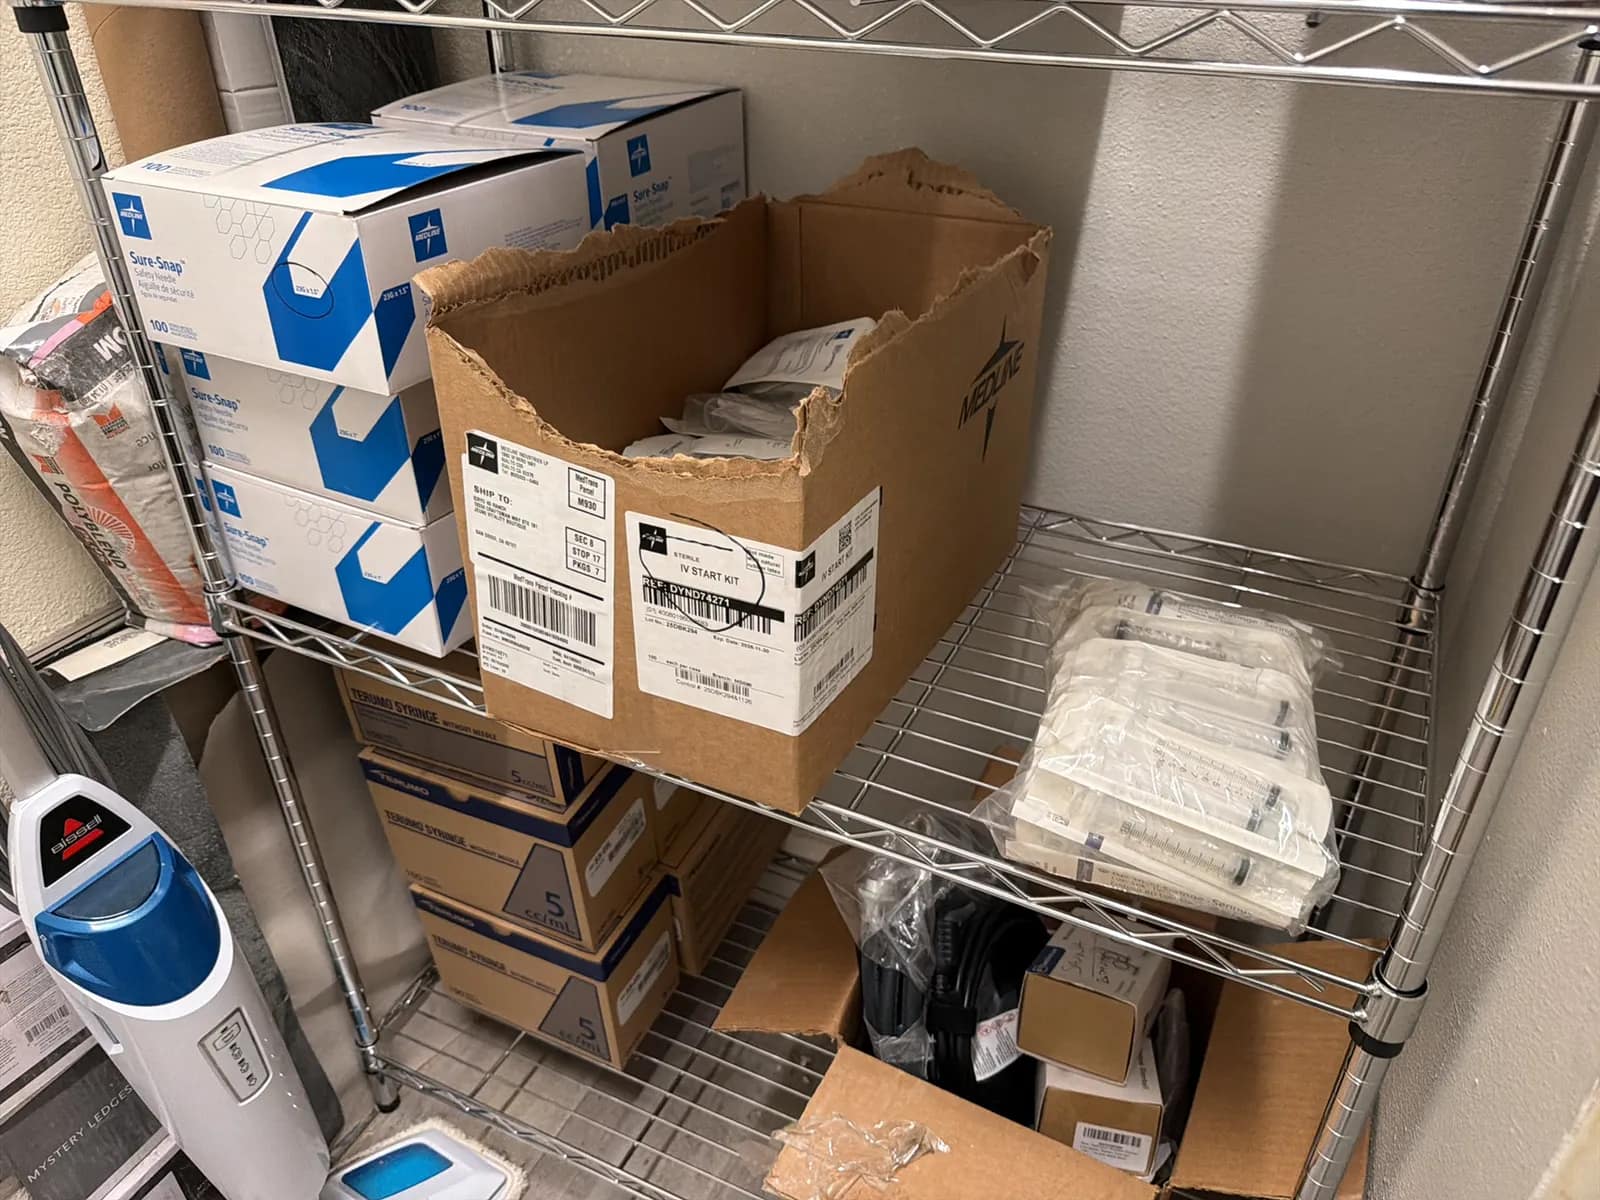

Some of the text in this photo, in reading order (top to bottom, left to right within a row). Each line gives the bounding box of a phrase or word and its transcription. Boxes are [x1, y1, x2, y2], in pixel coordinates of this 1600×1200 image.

[415, 226, 441, 242] MEDLINE
[129, 251, 183, 276] Sure-Snap
[150, 319, 169, 333] 100
[958, 341, 1024, 430] MEDLINE
[192, 387, 239, 412] Sure-Snap
[208, 444, 226, 458] 100
[575, 473, 598, 488] MedTrans
[474, 485, 495, 498] SHIP
[498, 493, 512, 506] TO:
[578, 497, 597, 511] M930
[54, 481, 127, 570] POLYBLEND
[574, 533, 594, 548] SEC 8
[572, 547, 601, 563] STOP 17
[674, 551, 700, 563] STERILE
[572, 560, 599, 576] PKGS 7
[680, 563, 740, 586] IV START KIT
[828, 556, 845, 578] START
[642, 578, 730, 607] REF: DYND74271
[351, 687, 394, 711] TERUMO
[395, 700, 439, 724] SYRINGE
[380, 771, 430, 797] TERUMO
[511, 770, 521, 784] 5
[545, 891, 565, 918] 5
[578, 1017, 596, 1041] 5
[27, 1084, 134, 1183] MYSTERY LEDGES
